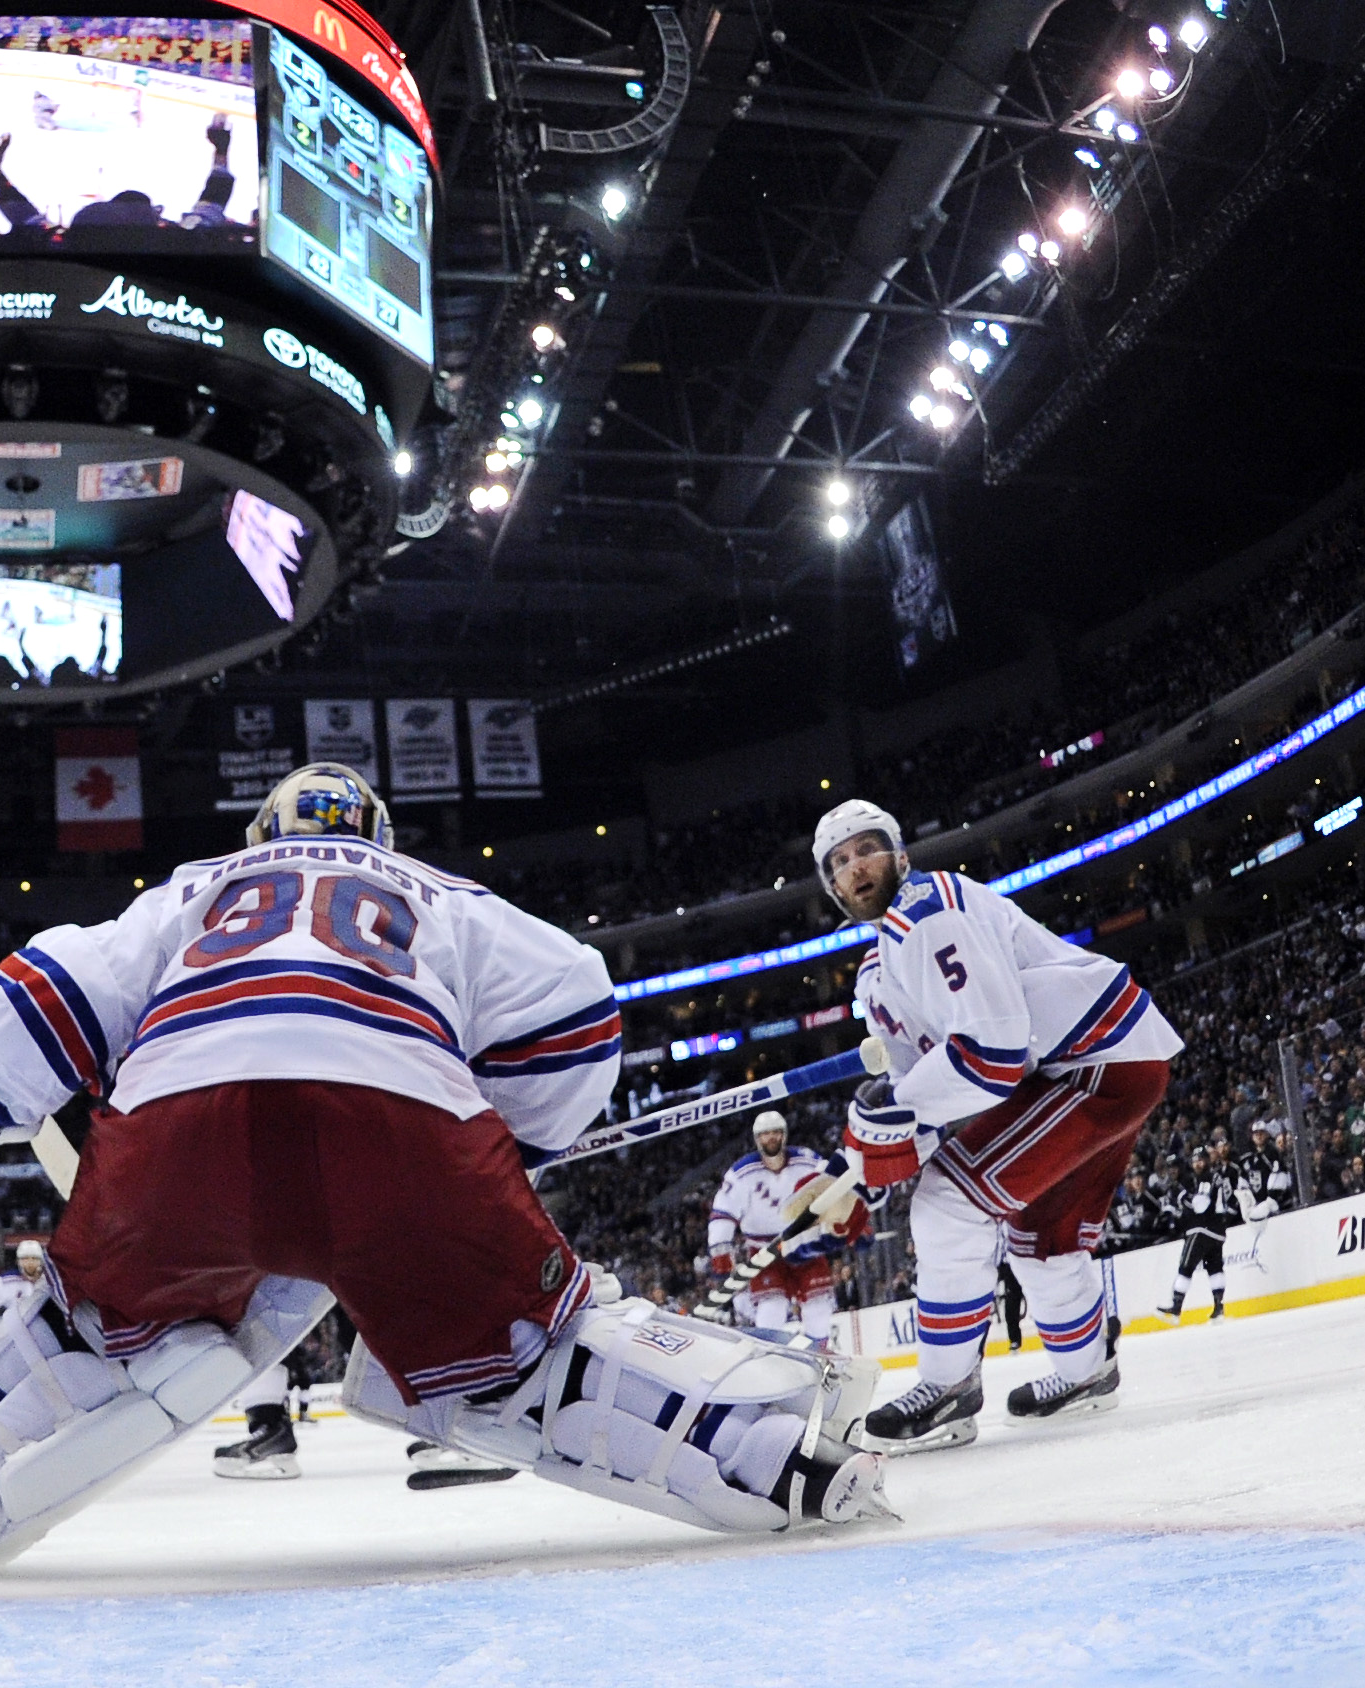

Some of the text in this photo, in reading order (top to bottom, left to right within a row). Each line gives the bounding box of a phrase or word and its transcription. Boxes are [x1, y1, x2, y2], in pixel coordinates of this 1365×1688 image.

[297, 122, 310, 146] 2
[393, 198, 407, 222] 2
[80, 274, 224, 331] Alberta
[183, 870, 419, 980] 30
[934, 943, 969, 993] 5
[659, 1090, 756, 1133] BAUER
